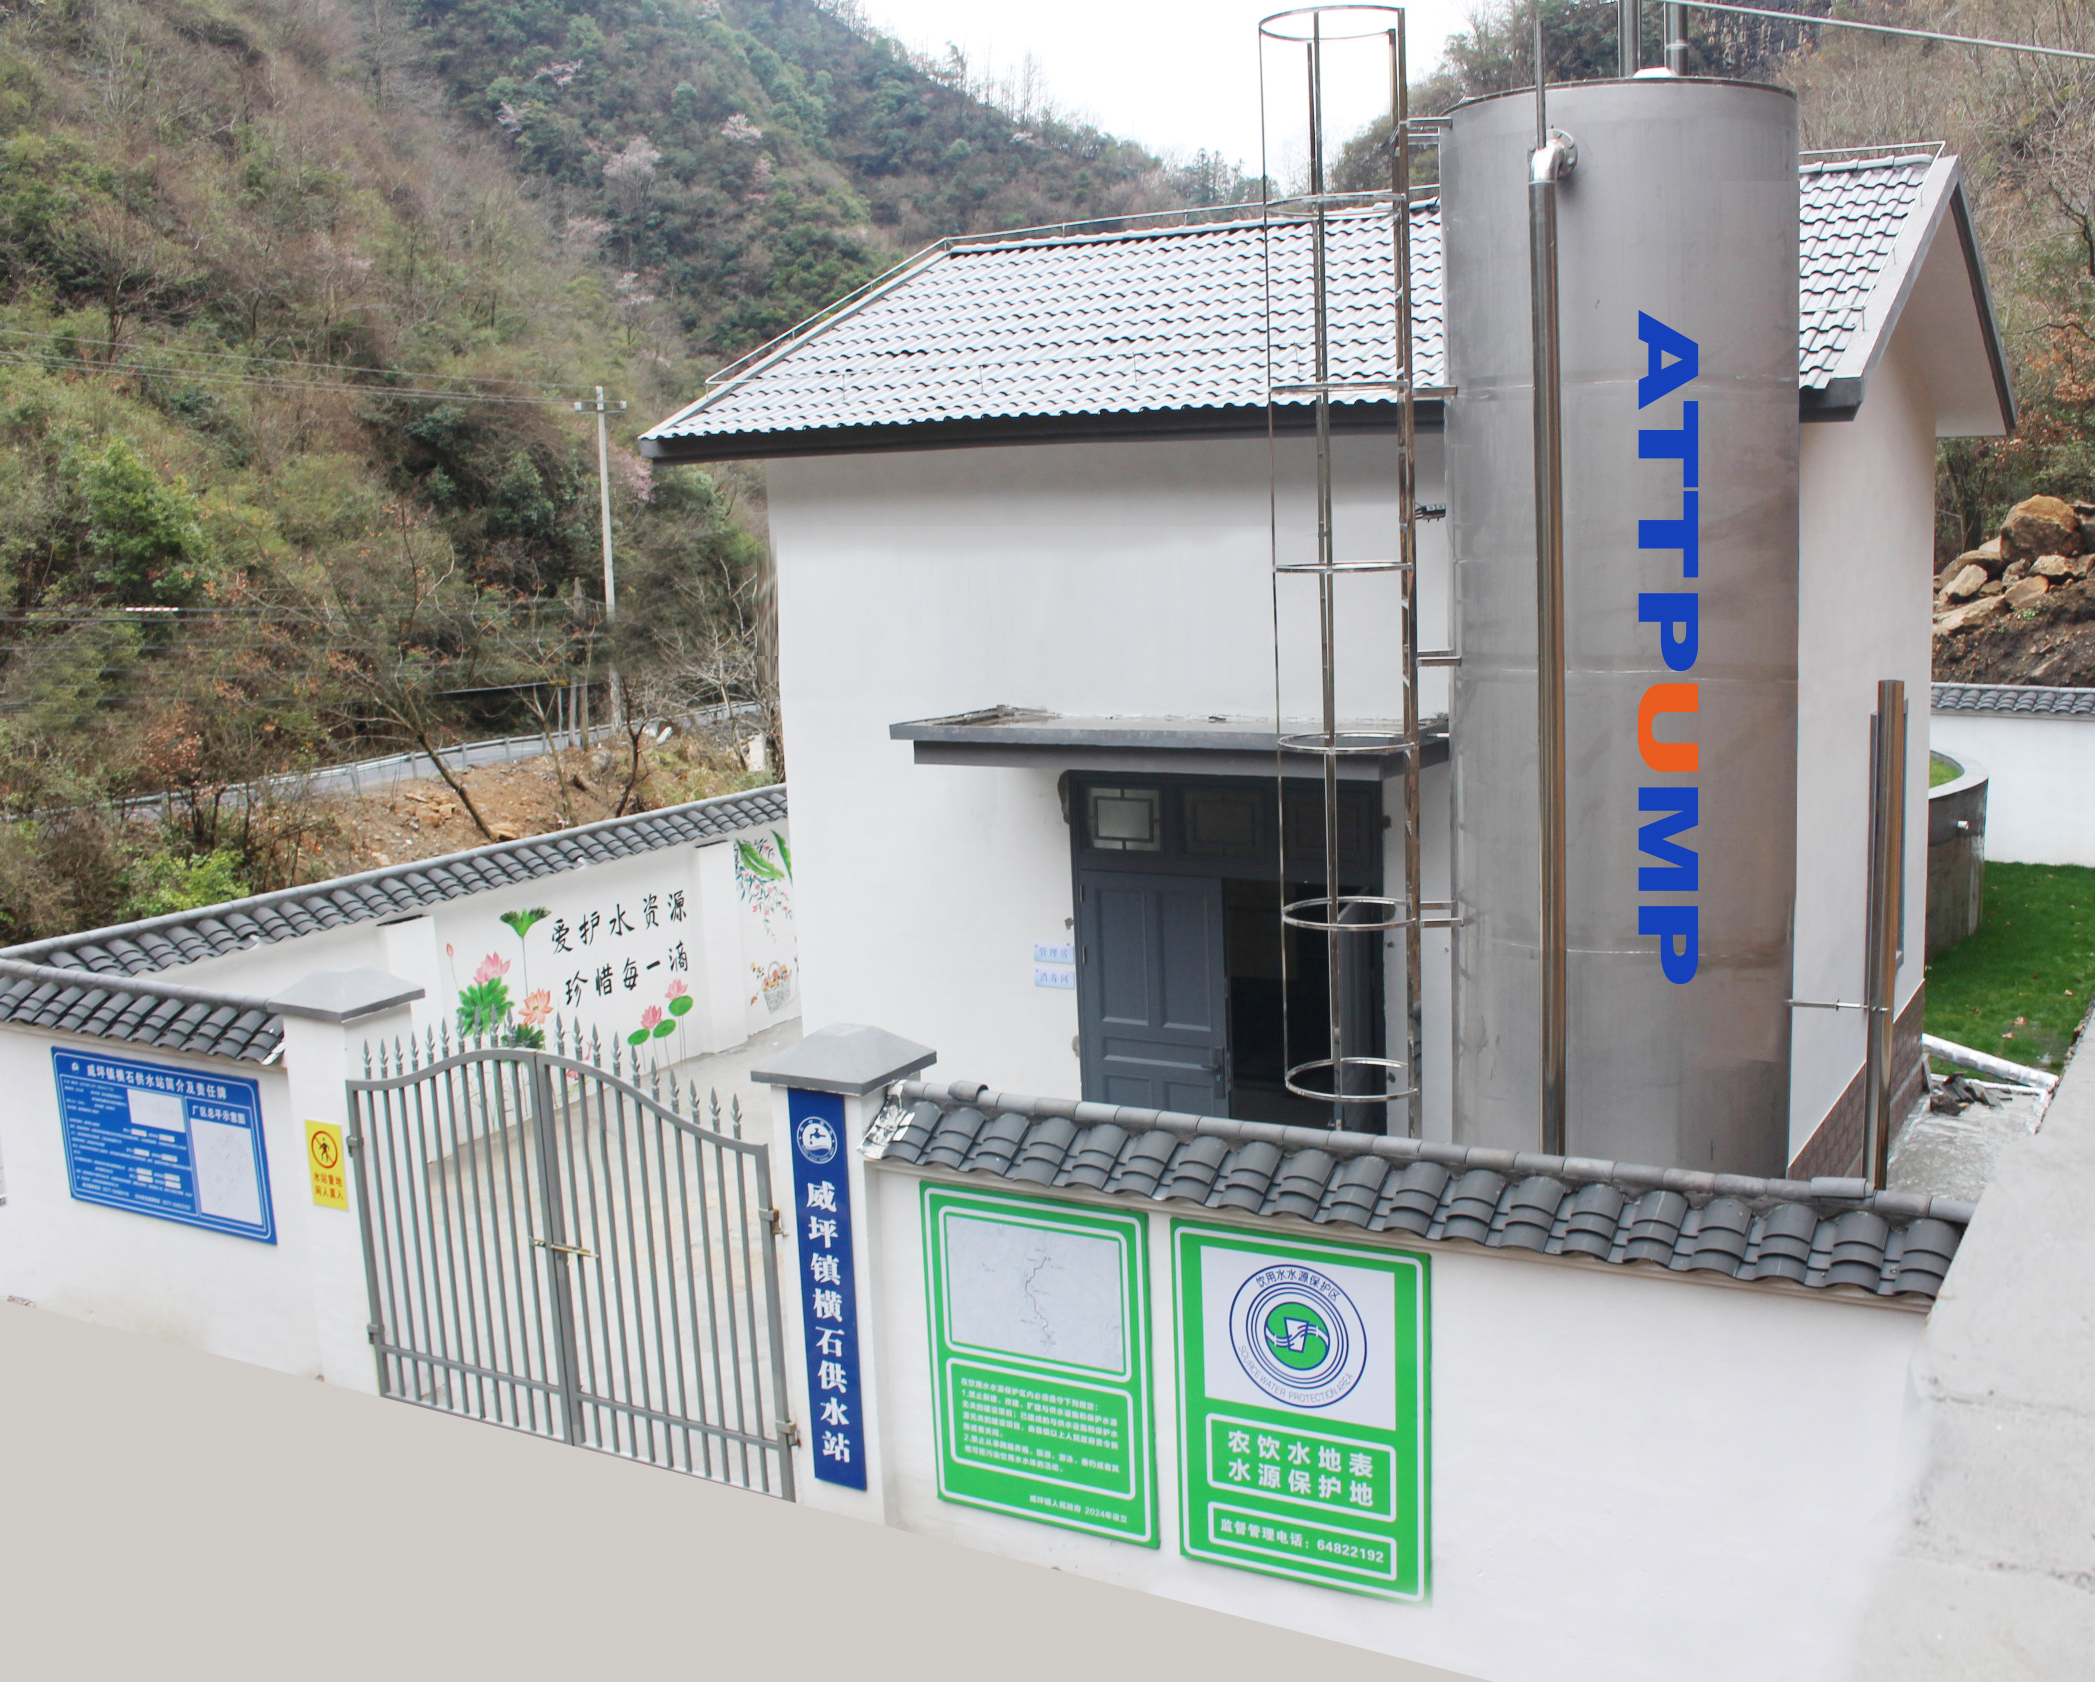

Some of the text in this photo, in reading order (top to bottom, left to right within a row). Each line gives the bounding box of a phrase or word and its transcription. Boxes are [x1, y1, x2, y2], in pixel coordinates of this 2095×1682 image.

[551, 889, 688, 954] 爱护水资源
[565, 940, 689, 1007] 珍惜每一滴
[314, 1171, 342, 1187] 水站重地
[1256, 1268, 1341, 1302] 饮用水水源保护区
[806, 1181, 851, 1463] 威坪镇横石供水站
[1238, 1345, 1353, 1404] SOURCE WATER PROTECTION AREA
[1228, 1430, 1374, 1479] 农饮水地表
[1228, 1459, 1374, 1507] 水源保护地
